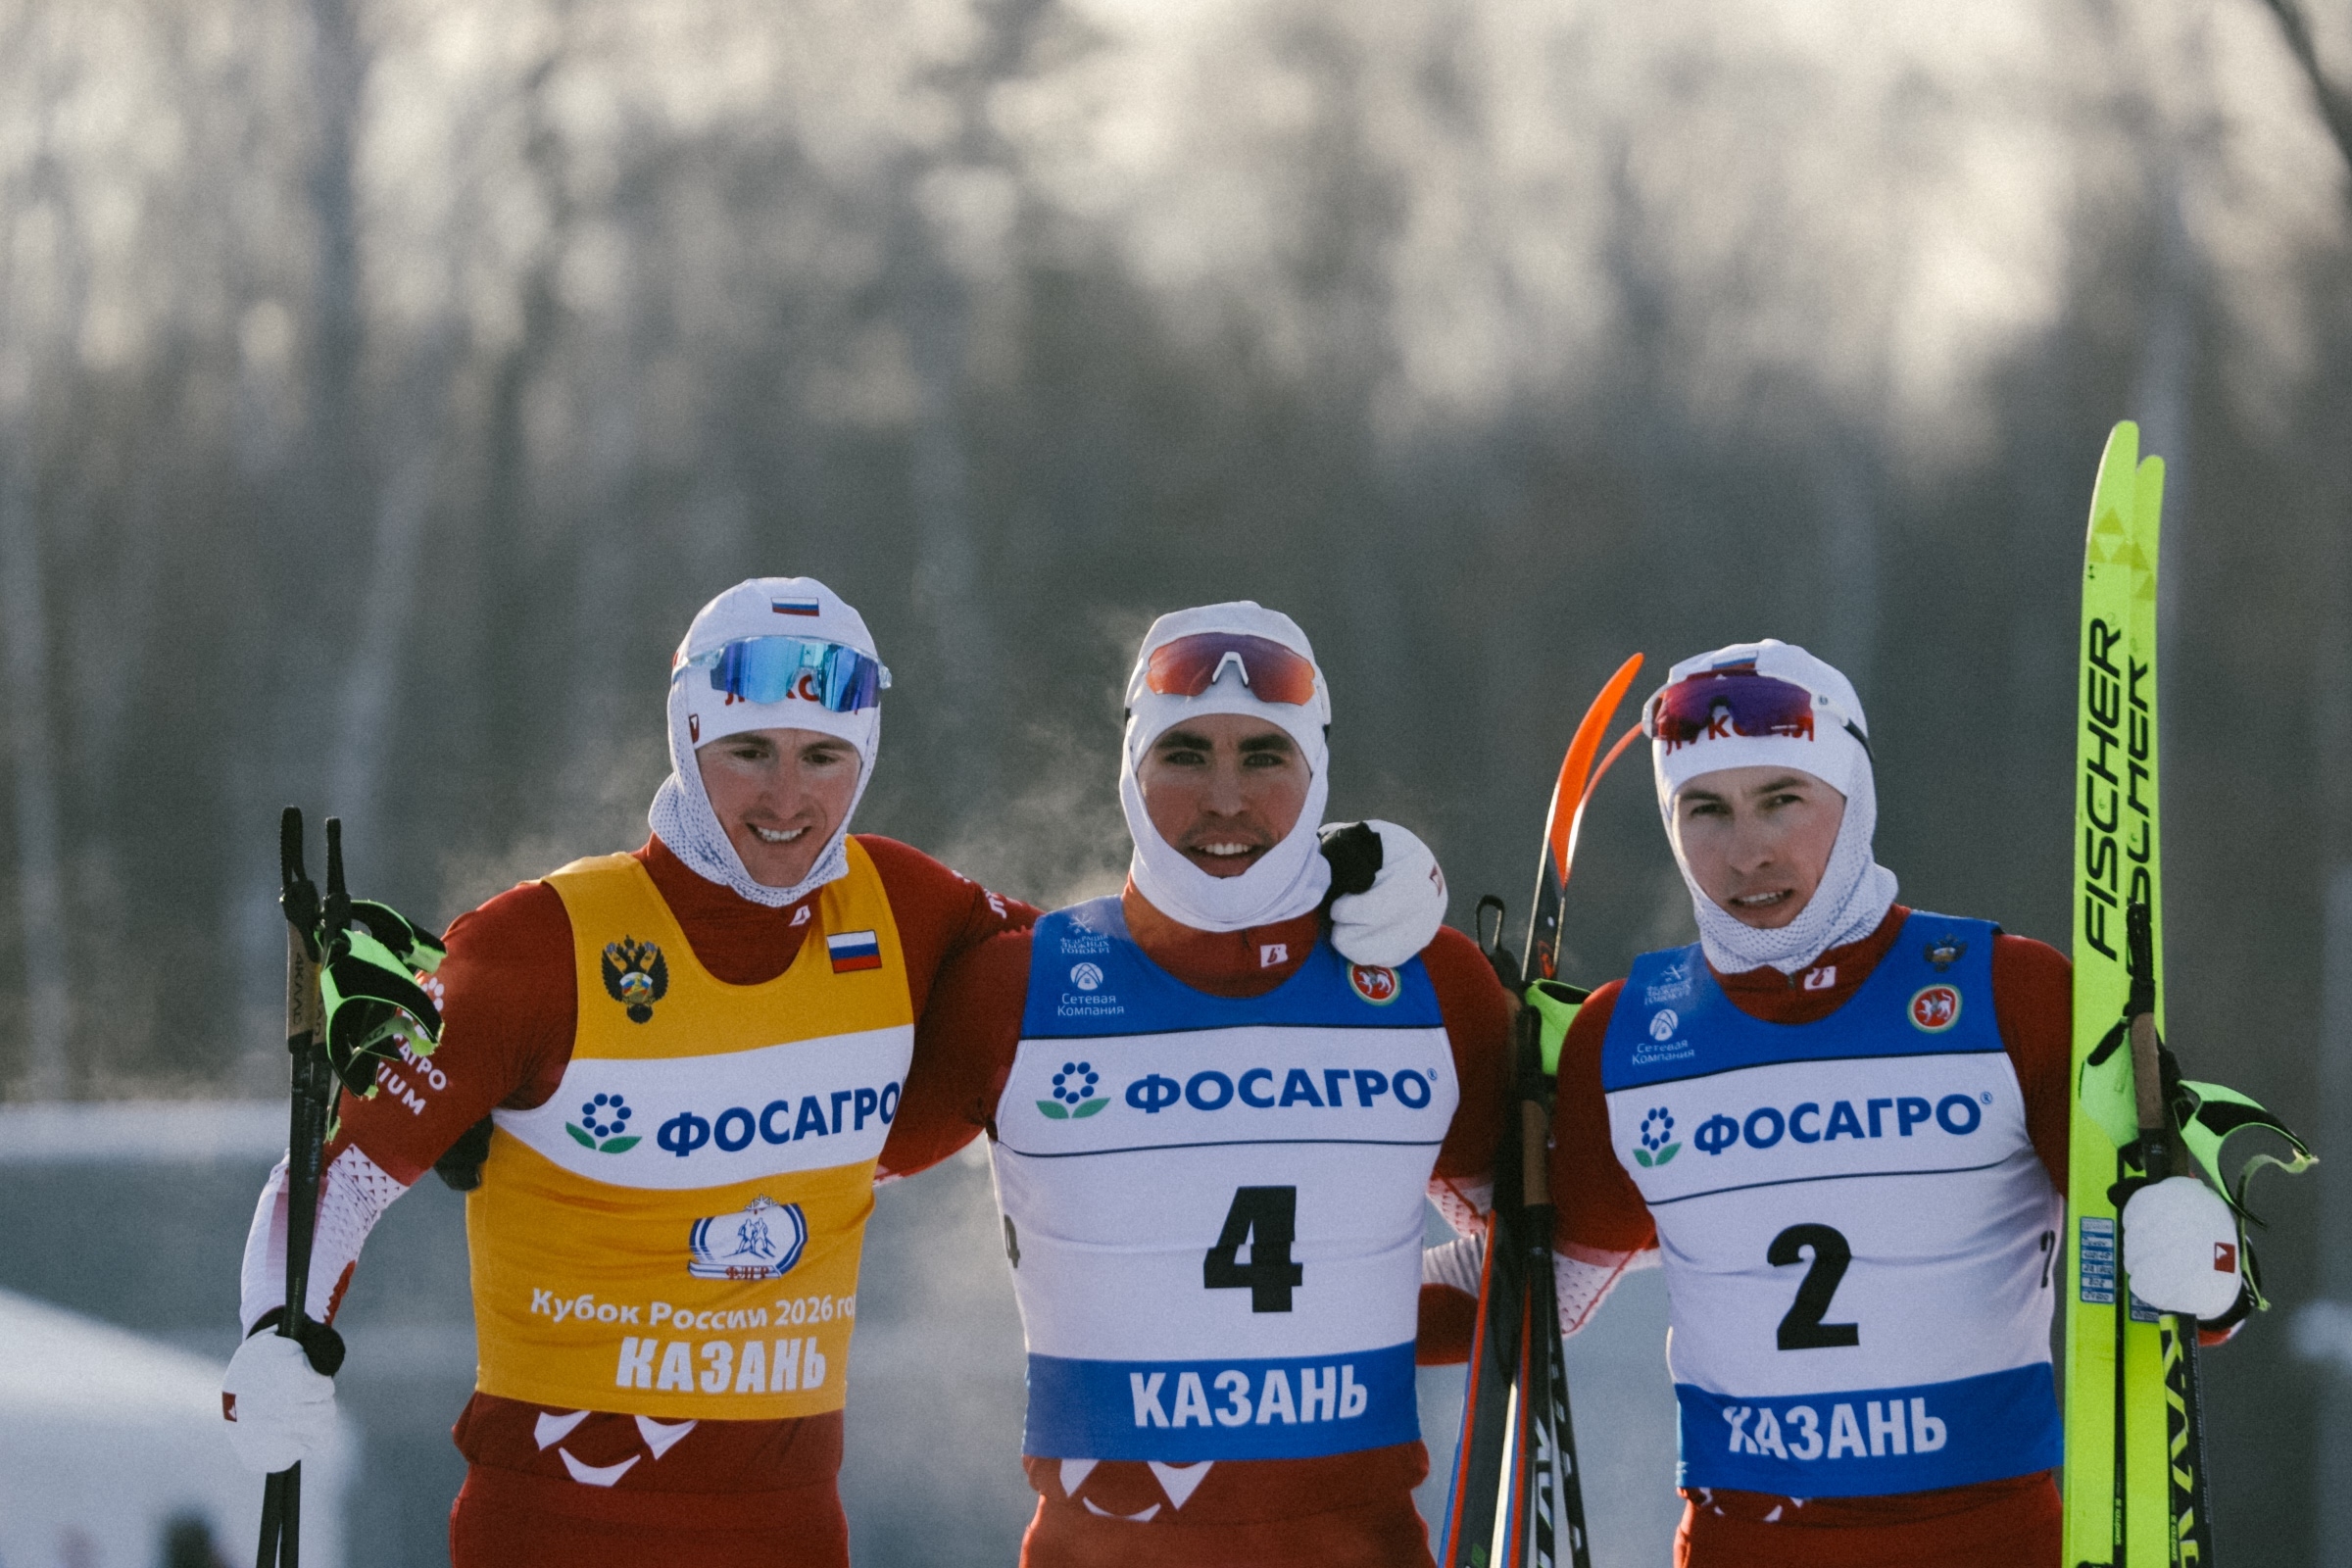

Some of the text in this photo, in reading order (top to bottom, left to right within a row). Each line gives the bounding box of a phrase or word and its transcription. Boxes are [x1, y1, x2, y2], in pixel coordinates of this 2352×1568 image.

[2085, 617, 2122, 962] FISCHER
[1057, 1005, 1125, 1016] Компания
[1061, 993, 1116, 1004] Сетевая
[1632, 1049, 1695, 1065] Компания
[1637, 1040, 1689, 1054] Сетевая
[657, 1081, 901, 1157] ФОСАГРО
[1203, 1185, 1303, 1313] 4
[530, 1288, 639, 1323] Кубок
[650, 1301, 767, 1330] России
[774, 1295, 834, 1326] 2026
[1767, 1222, 1860, 1350] 2
[615, 1336, 826, 1394] КАЗАНЬ
[1129, 1364, 1368, 1429] КАЗАНЬ
[1722, 1396, 1947, 1460] КАЗАНЬ
